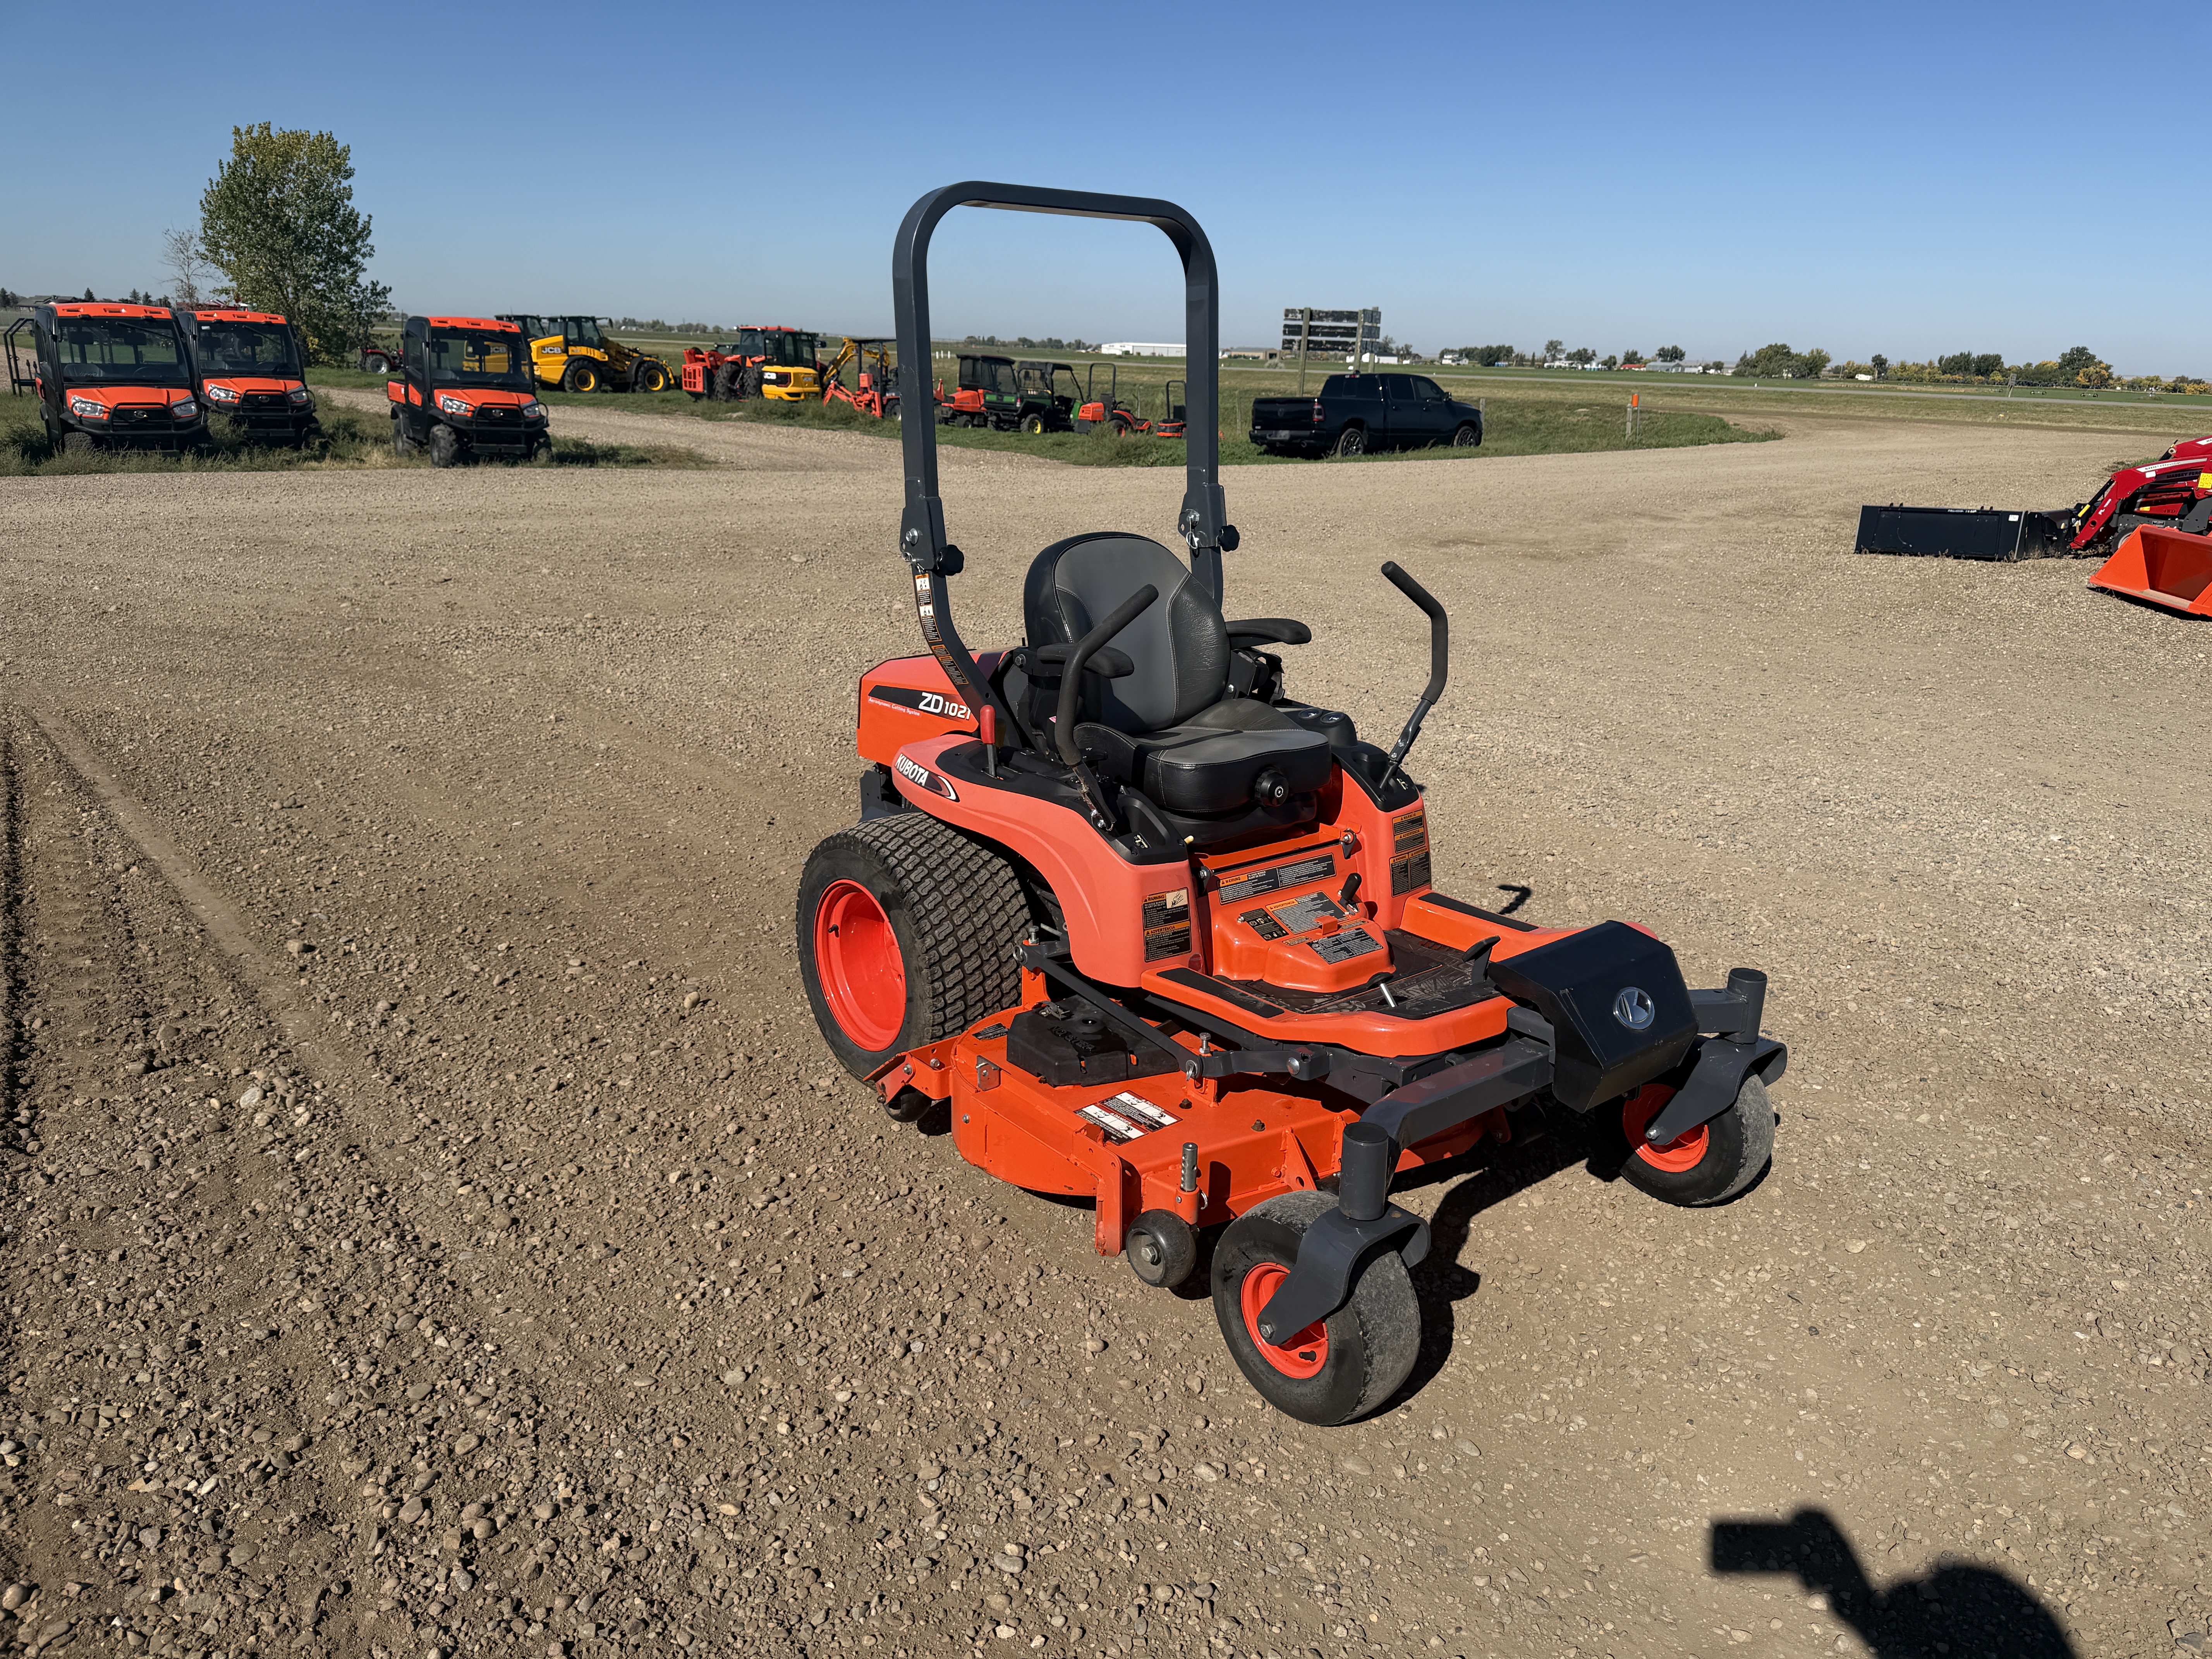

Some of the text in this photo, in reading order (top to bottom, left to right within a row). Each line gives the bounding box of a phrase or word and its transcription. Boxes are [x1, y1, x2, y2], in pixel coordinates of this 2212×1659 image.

[542, 346, 562, 354] JCB
[869, 697, 920, 716] Aerodynamic Cutting System
[895, 753, 929, 787] KUBOTA
[1151, 925, 1175, 934] ADVERTENCIA
[1049, 1026, 1095, 1050] NO STEP
[1113, 1114, 1132, 1125] DANGER
